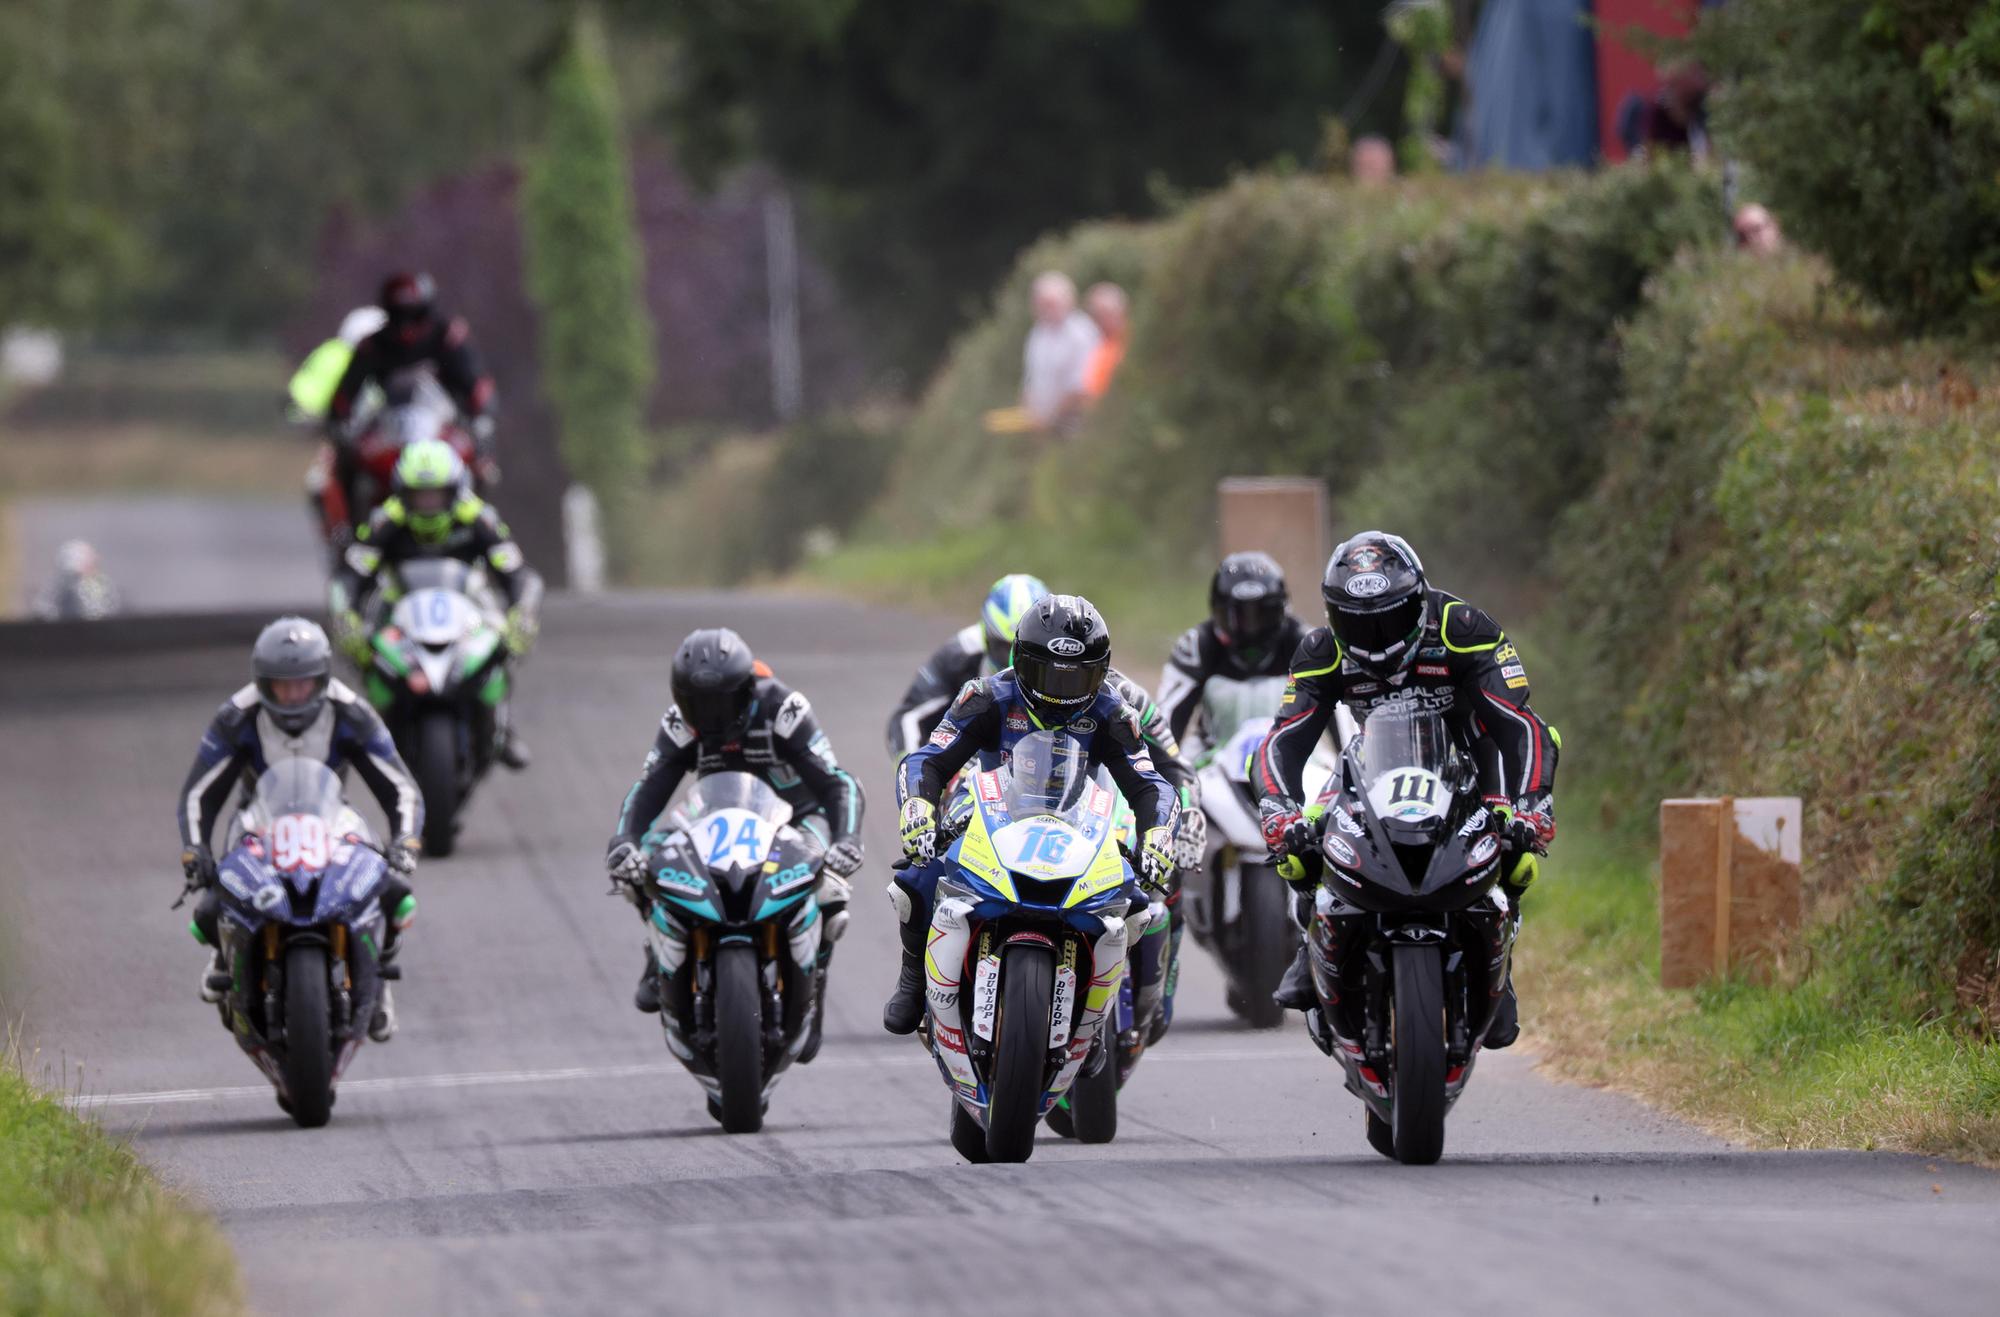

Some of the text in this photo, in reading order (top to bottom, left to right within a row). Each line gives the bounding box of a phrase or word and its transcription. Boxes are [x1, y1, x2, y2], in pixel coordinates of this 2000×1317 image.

[409, 596, 452, 627] 10
[1051, 639, 1081, 652] Arai
[1419, 666, 1447, 675] MOTUL
[1371, 686, 1433, 706] GLOBAL
[1424, 694, 1454, 709] LTD
[1389, 773, 1436, 804] 111
[1332, 805, 1365, 838] TRIUMPH
[1458, 806, 1490, 837] TRIUMPH
[272, 814, 330, 871] 99
[707, 816, 761, 863] 24
[1015, 826, 1074, 864] 16
[983, 972, 997, 1019] DUNLOP
[1052, 980, 1067, 1027] DUNLOP
